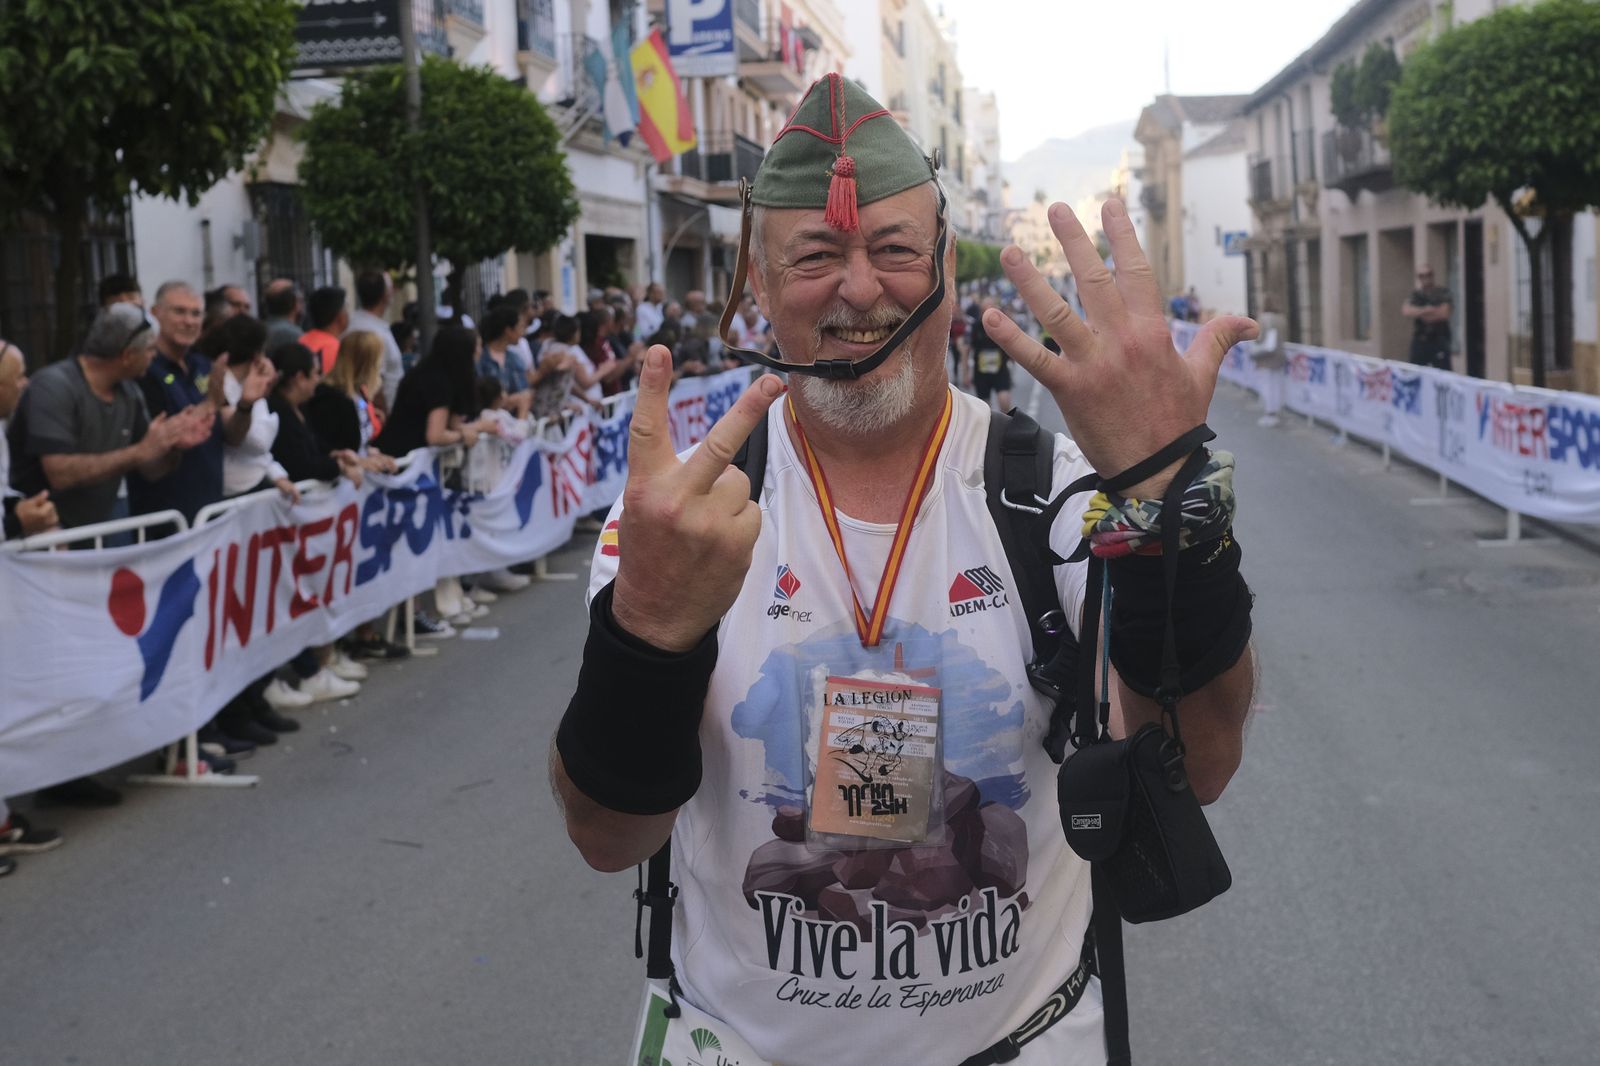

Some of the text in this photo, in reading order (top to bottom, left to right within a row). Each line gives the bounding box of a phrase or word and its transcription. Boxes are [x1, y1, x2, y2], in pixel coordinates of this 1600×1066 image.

[824, 693, 845, 705] LA
[758, 890, 1021, 980] Vive la vida
[776, 973, 1006, 1017] Cruz de la Esperanza
